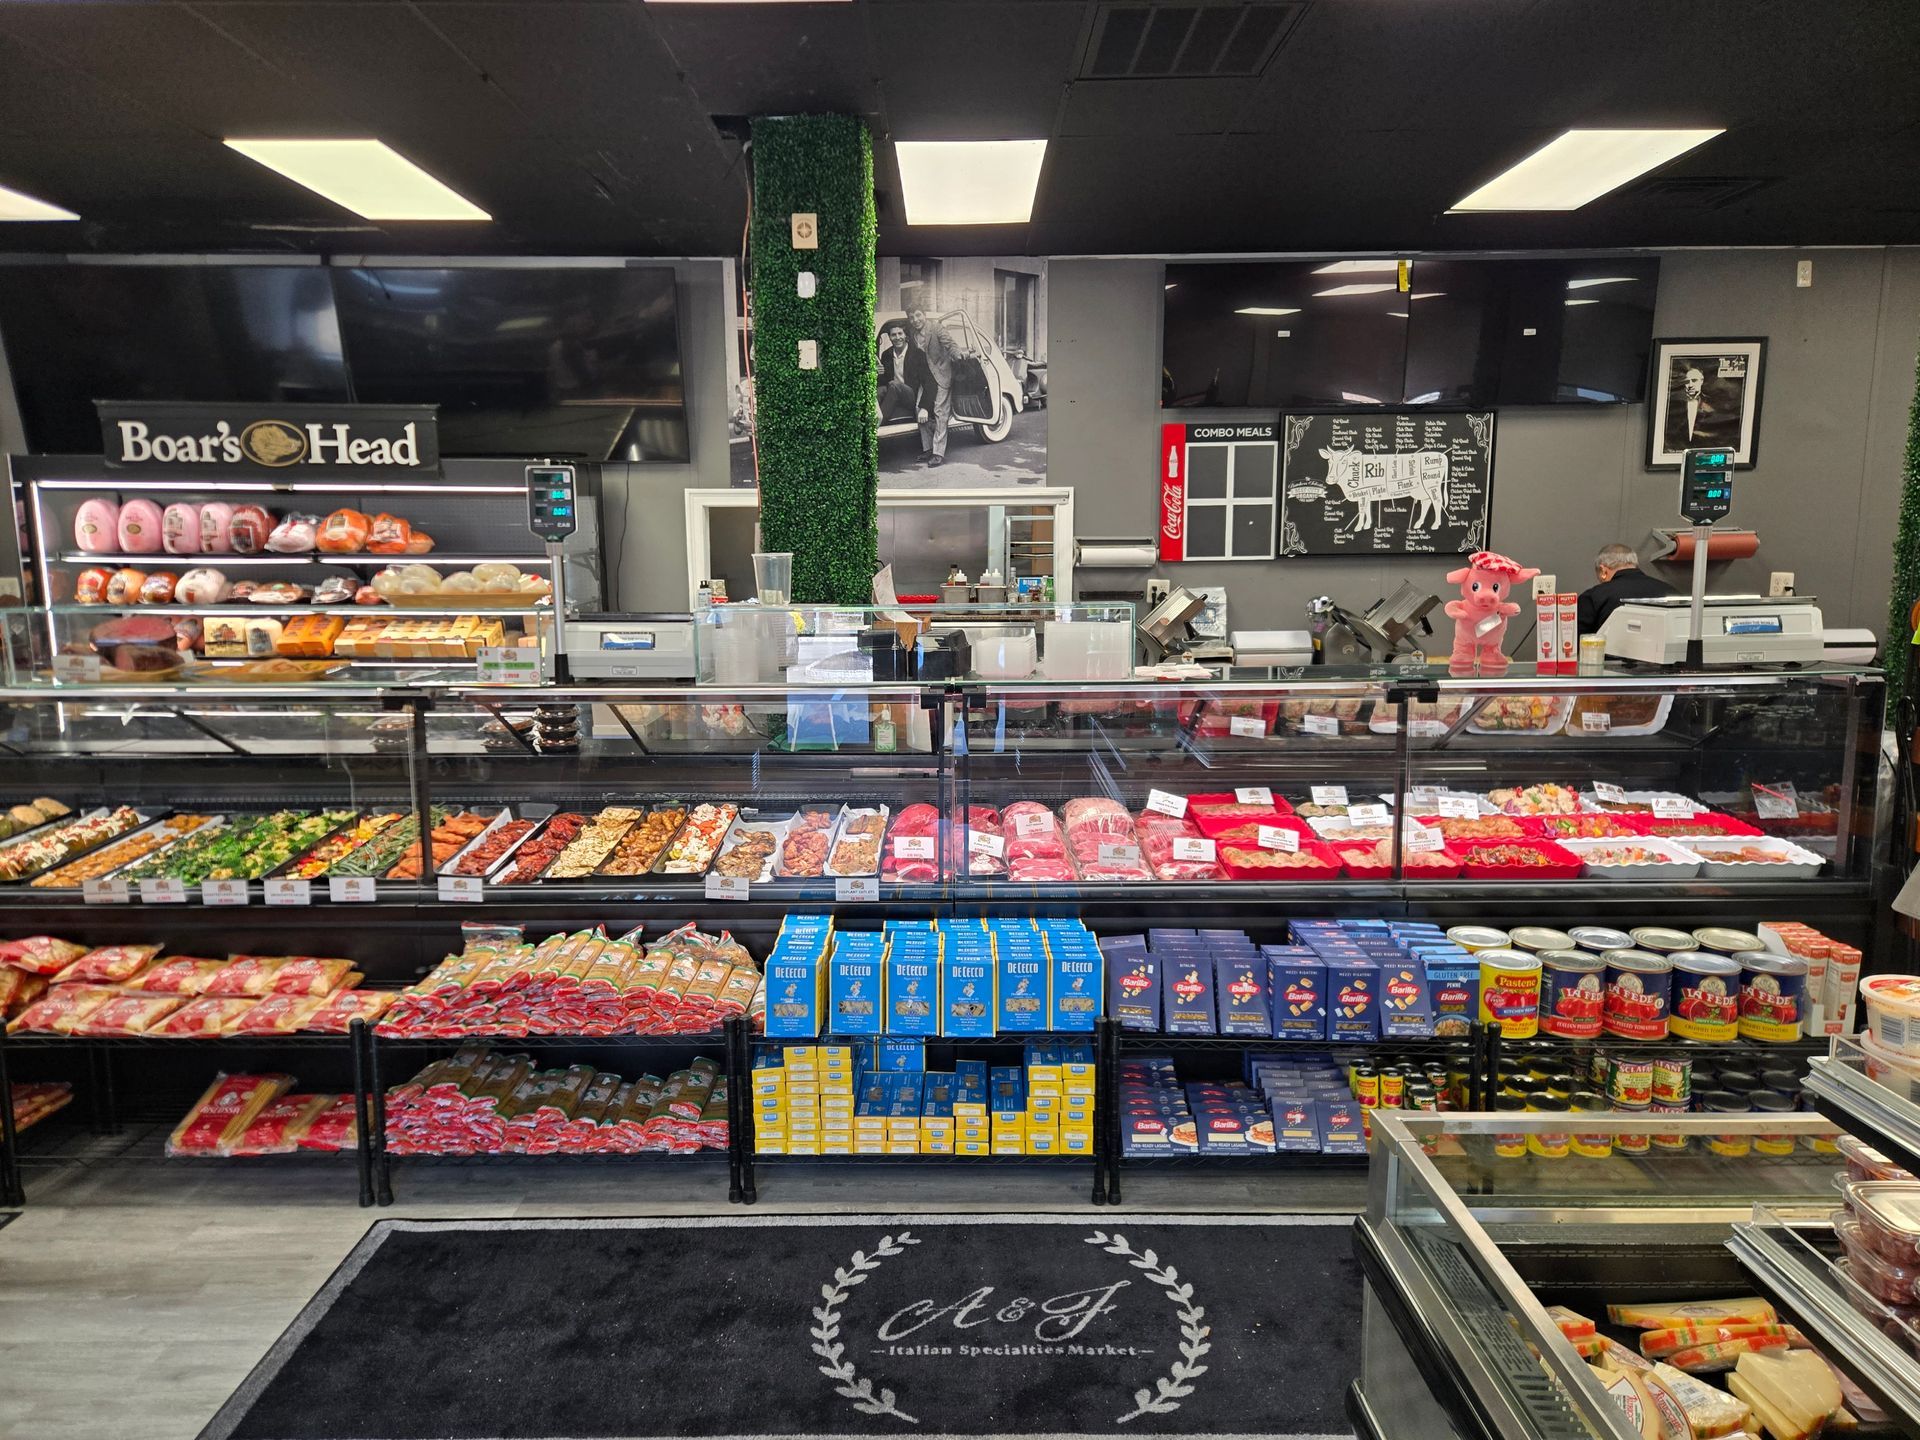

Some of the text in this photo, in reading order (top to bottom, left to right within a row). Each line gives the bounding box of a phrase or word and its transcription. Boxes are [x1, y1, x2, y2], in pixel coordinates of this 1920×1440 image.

[1194, 427, 1272, 438] COMBO MEALS
[118, 420, 420, 466] Boar's Head
[1424, 456, 1442, 465] Rump
[1347, 461, 1360, 489] Chuck
[1365, 462, 1384, 479] Rib
[1423, 470, 1441, 480] Round
[1372, 487, 1386, 496] Plate
[785, 967, 807, 978] CECCO
[849, 965, 871, 976] CECCO
[906, 964, 928, 976] CECCO
[962, 966, 984, 978] CECCO
[1017, 962, 1038, 974] CECCO
[1072, 961, 1092, 973] CECCO
[1122, 978, 1149, 987] Barilla
[1176, 984, 1203, 992] Barilla
[1499, 978, 1536, 987] Pastene
[1391, 986, 1418, 995] Barilla
[1567, 988, 1581, 997] LA
[1608, 983, 1654, 1003] LA FEDE
[1742, 984, 1791, 1005] LA FEDE
[1288, 993, 1314, 1001] Barilla
[1440, 993, 1467, 1001] Barilla
[1687, 989, 1737, 1006] LA FEDE
[1137, 1122, 1162, 1130] Barilla
[1213, 1121, 1238, 1129] Barilla
[878, 1287, 994, 1341] A
[996, 1298, 1036, 1323] &
[889, 1344, 1138, 1357] Italian Specialties Market
